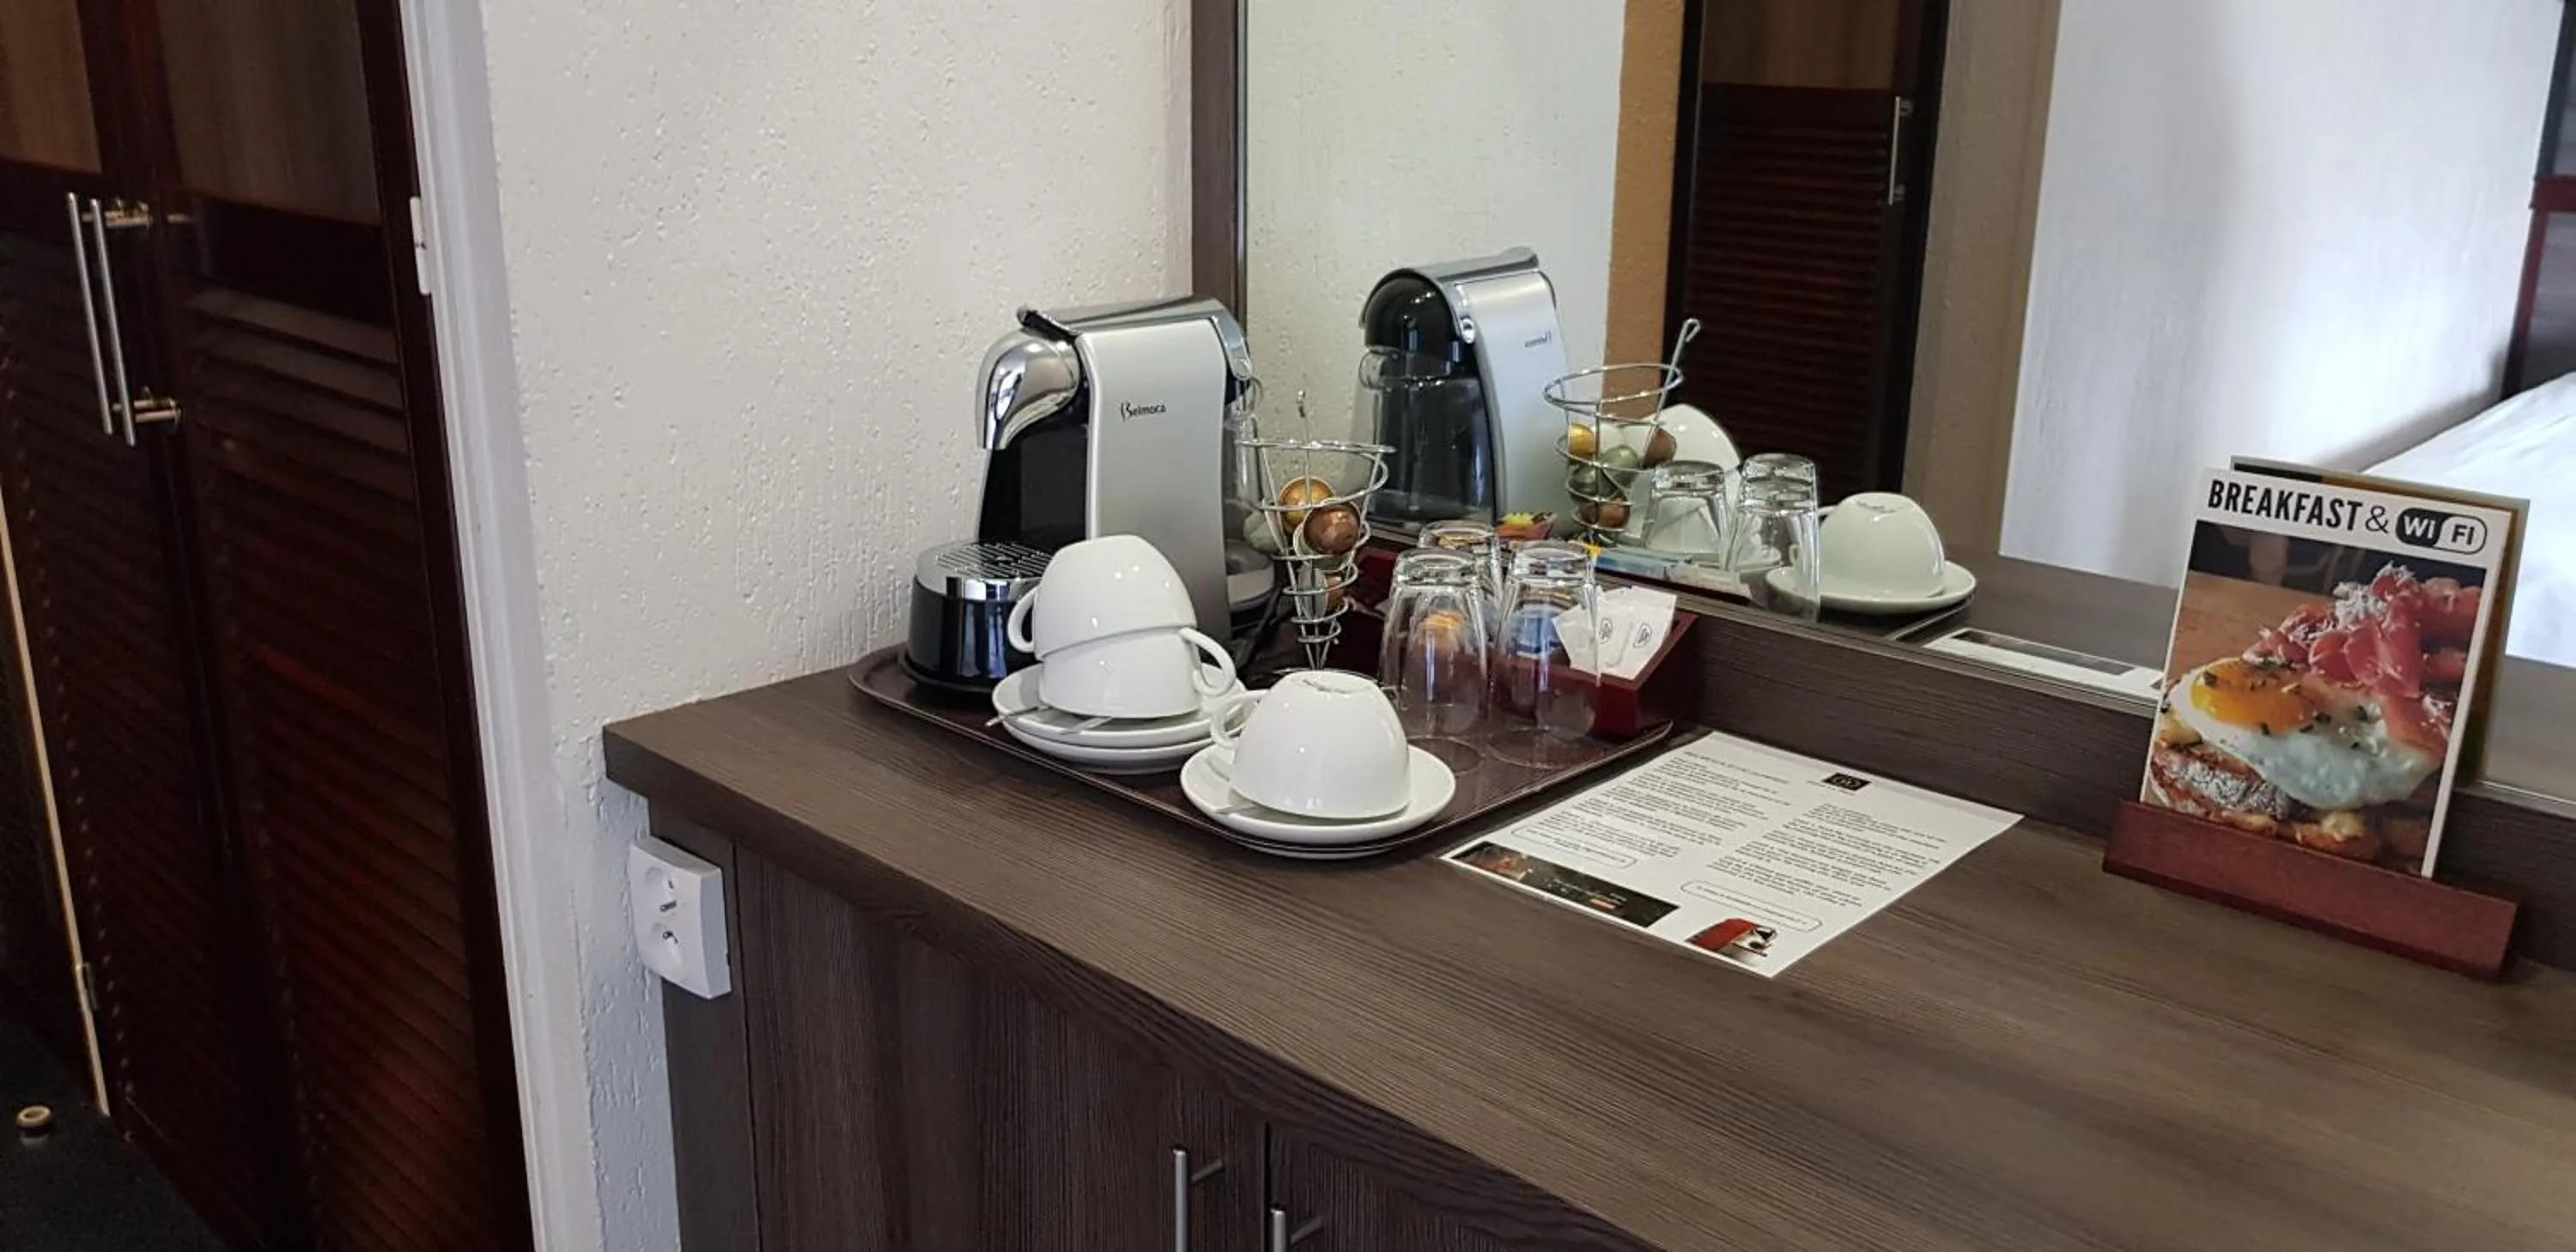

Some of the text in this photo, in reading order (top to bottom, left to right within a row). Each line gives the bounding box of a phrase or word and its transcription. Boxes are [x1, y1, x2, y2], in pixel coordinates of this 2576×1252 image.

[2208, 479, 2363, 531] BREAKFAST
[2365, 505, 2389, 533] &
[2451, 524, 2475, 545] FI
